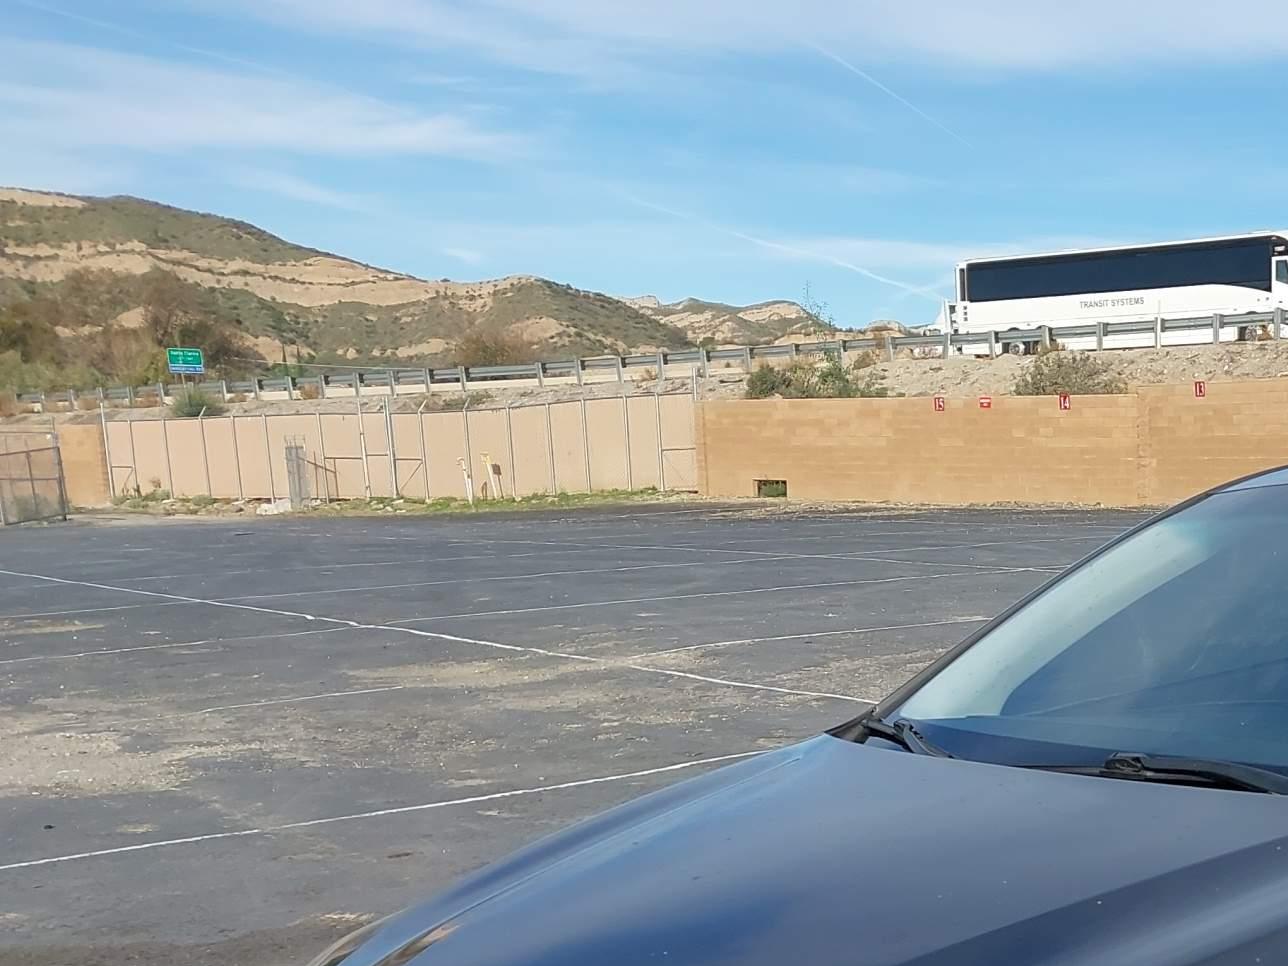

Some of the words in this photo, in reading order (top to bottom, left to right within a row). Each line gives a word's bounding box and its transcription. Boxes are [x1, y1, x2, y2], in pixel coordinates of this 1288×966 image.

[1080, 299, 1109, 309] TRANSIT
[1111, 297, 1144, 306] SYSTEMS
[1196, 383, 1205, 396] 13
[935, 398, 944, 410] 15
[1060, 396, 1070, 409] 14
